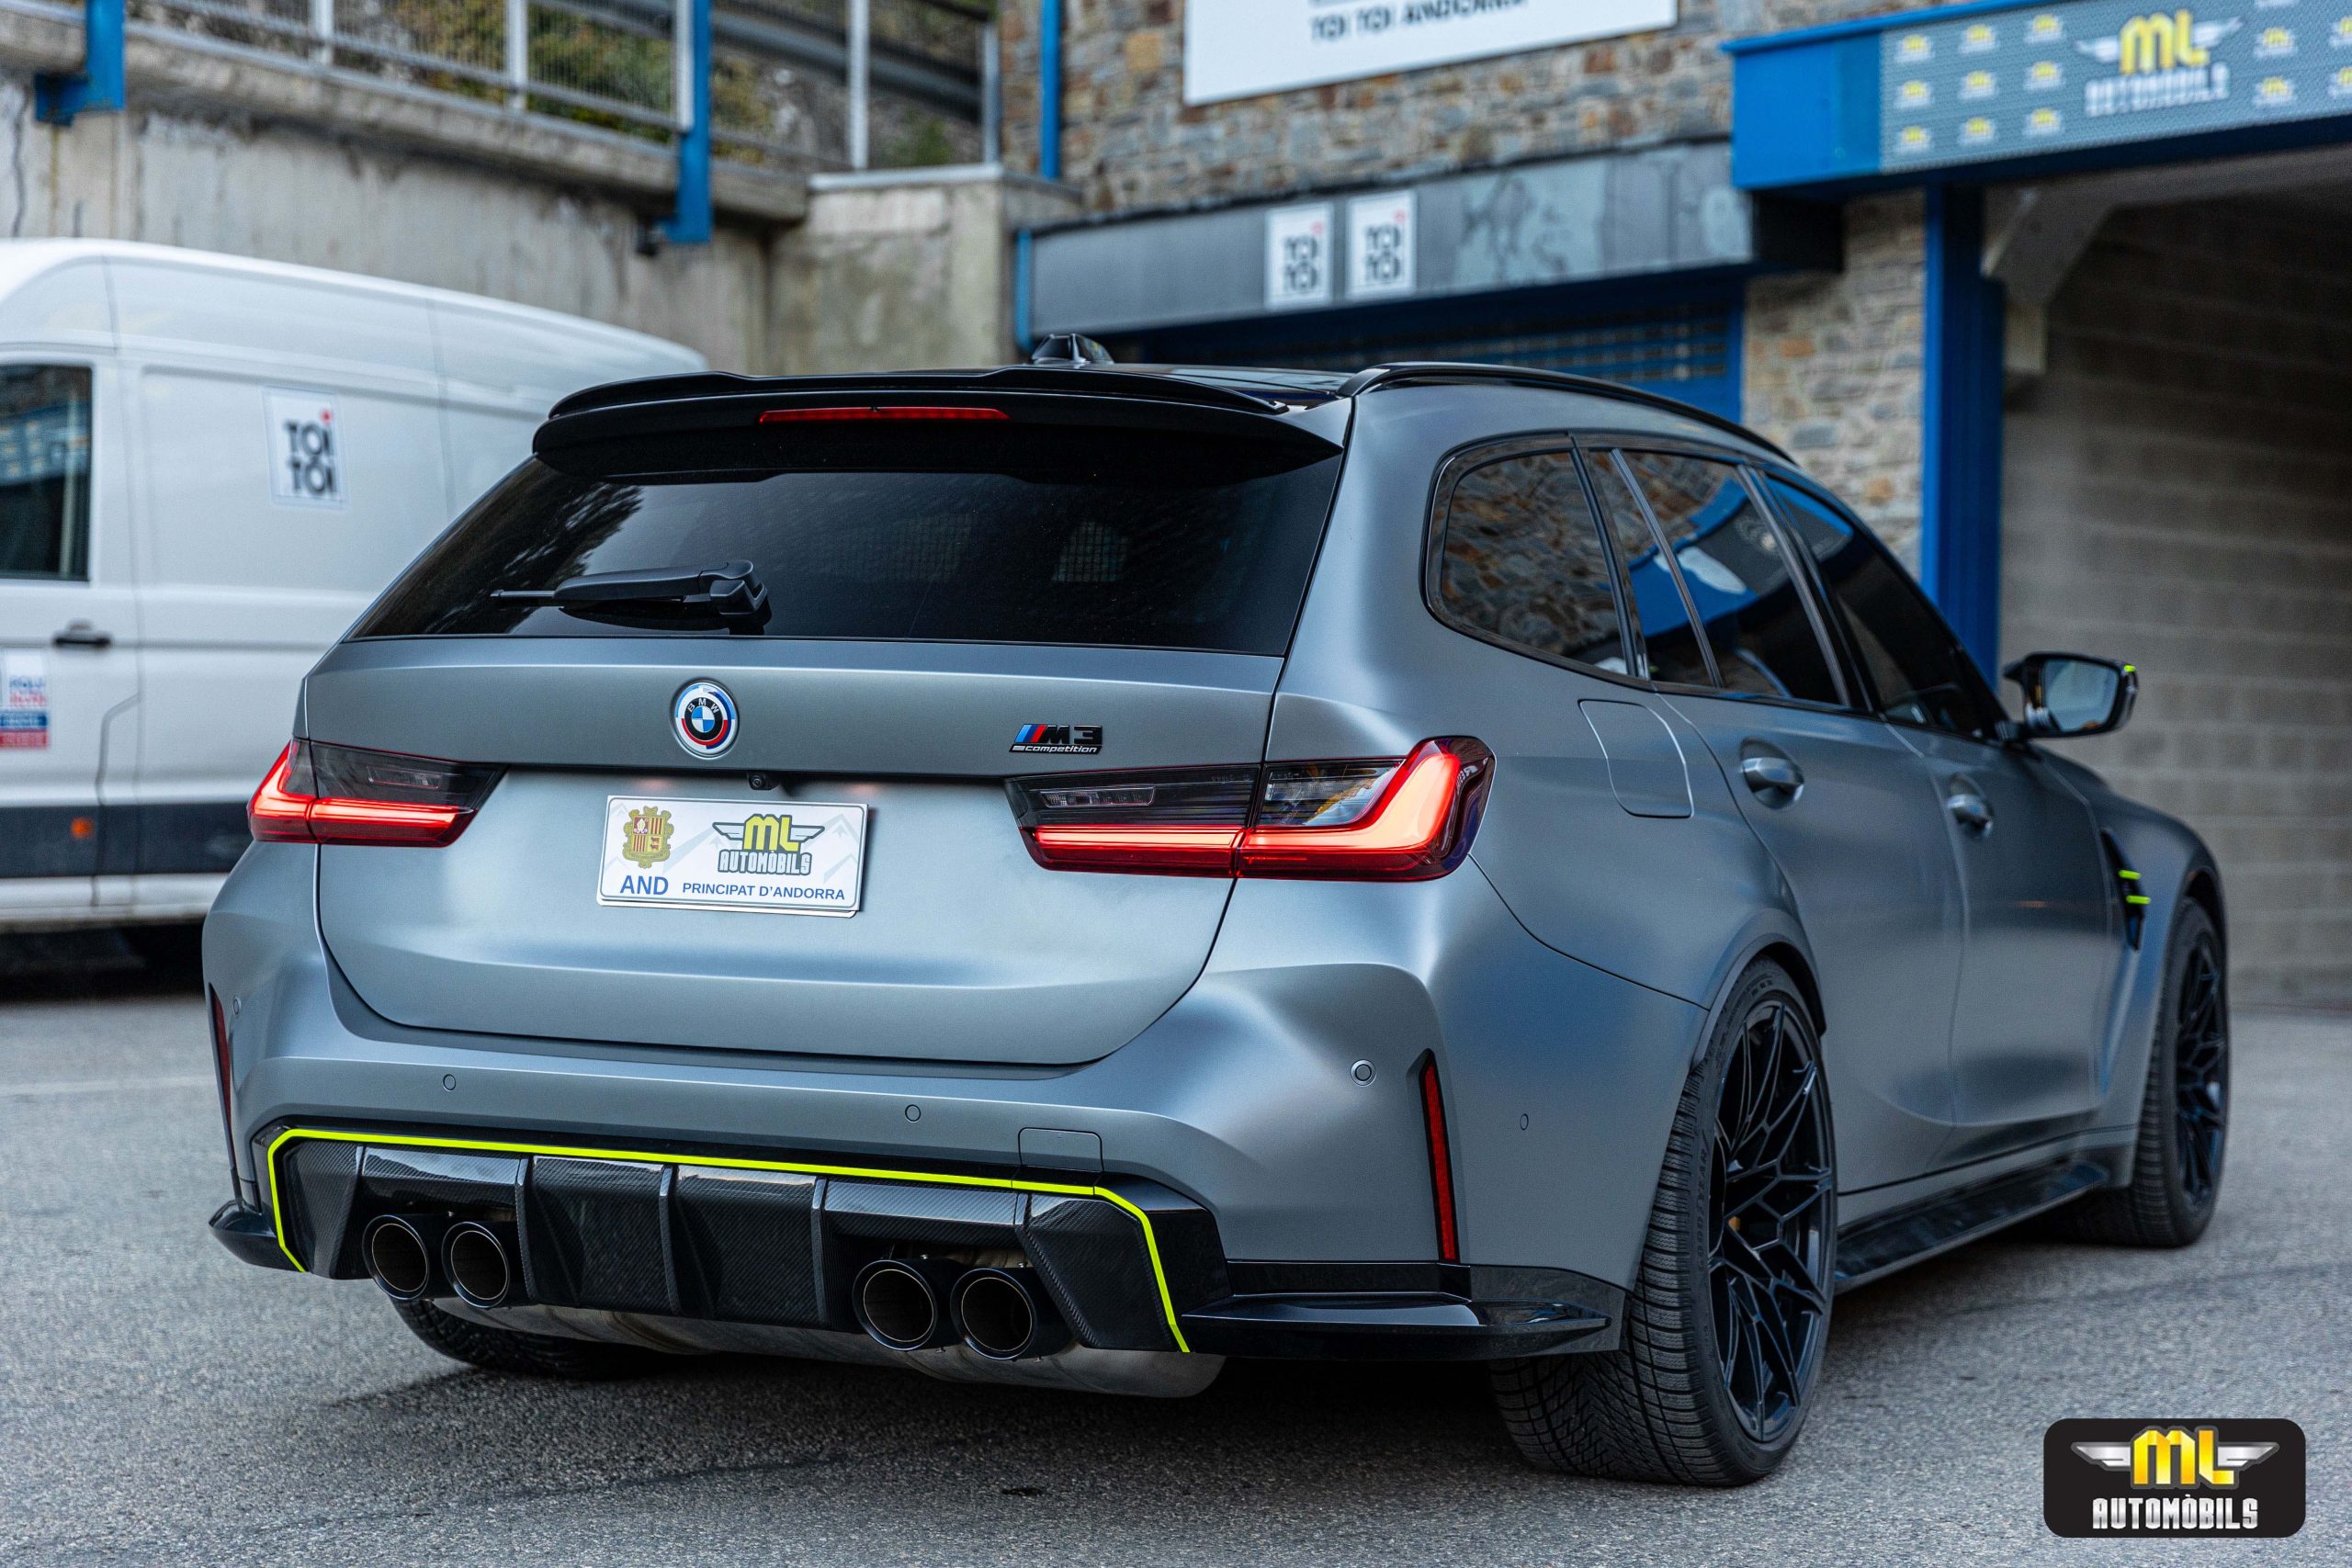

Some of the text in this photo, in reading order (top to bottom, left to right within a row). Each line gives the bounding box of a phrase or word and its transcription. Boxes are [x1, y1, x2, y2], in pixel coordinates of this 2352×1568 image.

[2120, 9, 2211, 75] ML
[687, 698, 719, 714] BMW
[1024, 745, 1098, 753] competition
[741, 814, 801, 852] ML
[620, 874, 669, 896] AND
[683, 882, 845, 900] PRINCIPAT D'ANDORRA
